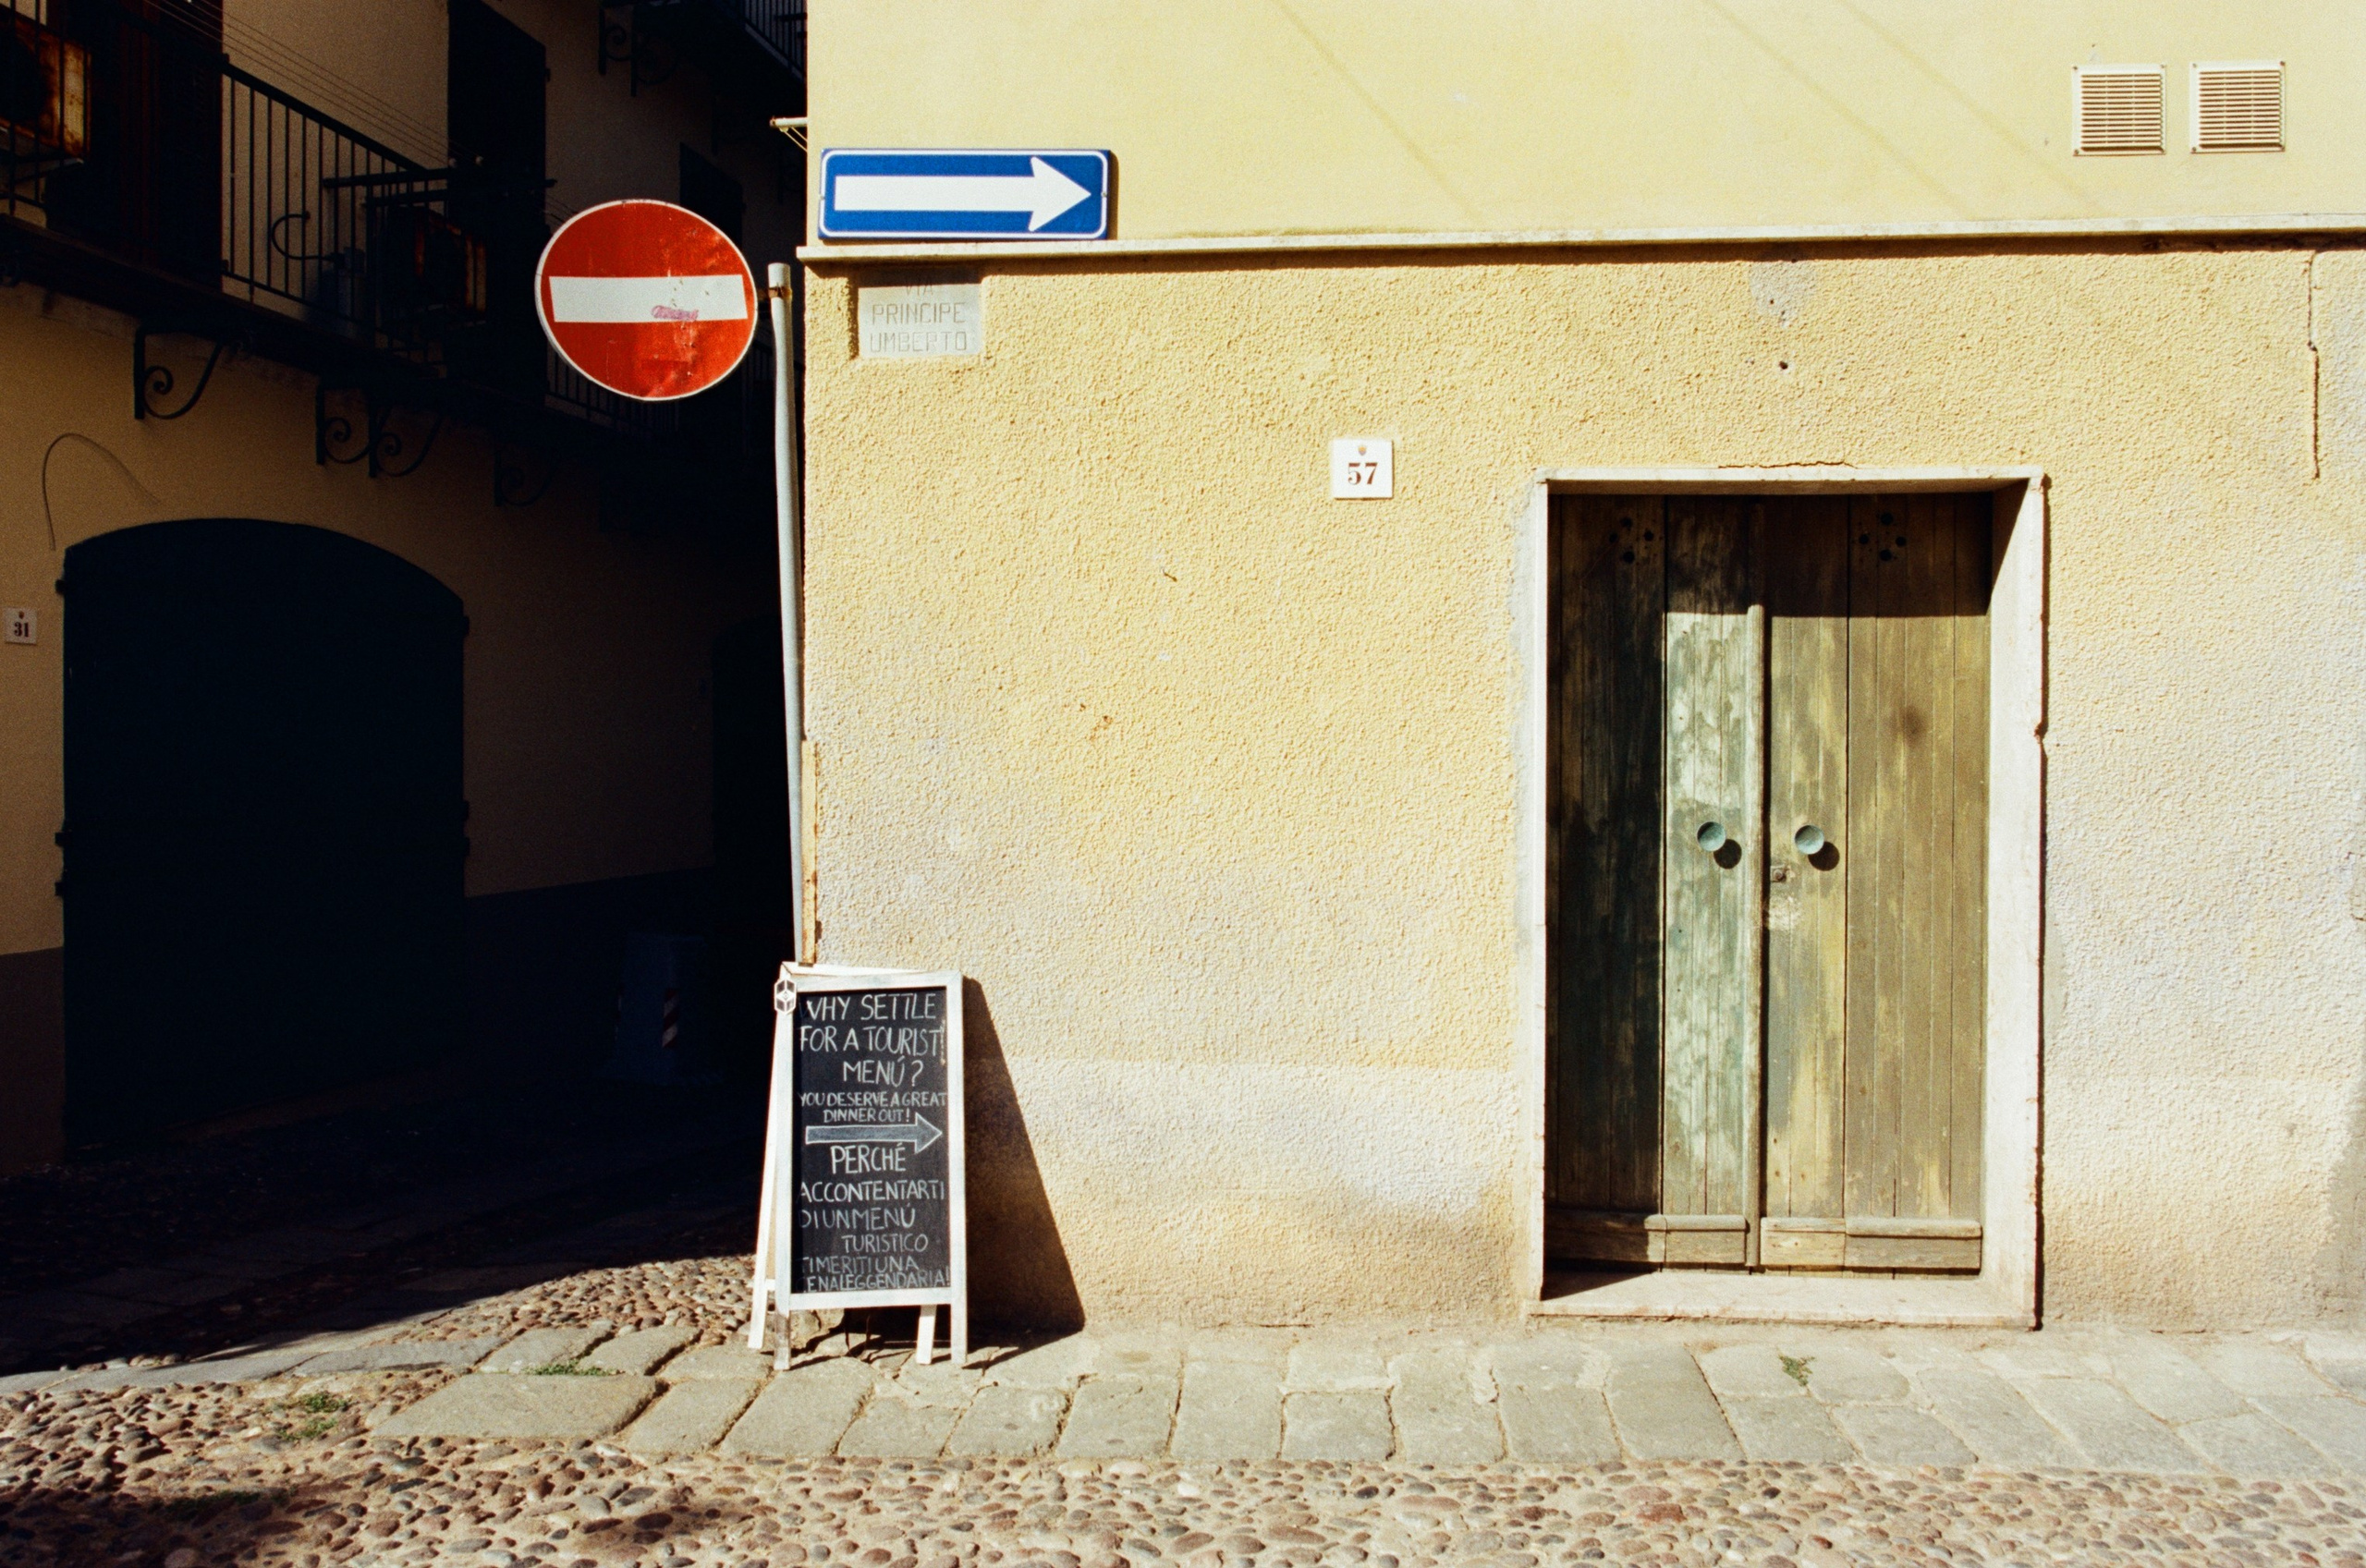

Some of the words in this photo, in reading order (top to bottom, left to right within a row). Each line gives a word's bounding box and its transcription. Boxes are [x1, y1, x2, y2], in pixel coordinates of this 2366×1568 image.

[872, 301, 967, 324] PRINCIPE
[870, 330, 968, 353] UMBERTO
[1348, 462, 1378, 485] 57
[14, 622, 30, 638] 31
[799, 996, 851, 1021] WHY
[860, 993, 936, 1020] SETTLE
[799, 1025, 837, 1051] FOR
[843, 1027, 860, 1051] A
[861, 1026, 942, 1057] TOURIST
[799, 1092, 824, 1107] YOU
[827, 1091, 888, 1107] DESERVE
[890, 1092, 900, 1107] A
[901, 1091, 946, 1107] GREAT
[823, 1108, 876, 1123] DINNER
[878, 1108, 910, 1122] OUT!
[830, 1142, 907, 1174] PERCHÉ
[798, 1178, 945, 1203] ACCONTENTARTI
[799, 1208, 819, 1229] DI
[823, 1208, 850, 1229] UN
[851, 1204, 916, 1231] MENÚ
[841, 1233, 929, 1253] TURISTICO
[797, 1256, 814, 1273] TI
[816, 1254, 872, 1274] MERITI
[874, 1256, 920, 1273] UNA
[840, 1266, 951, 1292] LEGGENDARIA!
